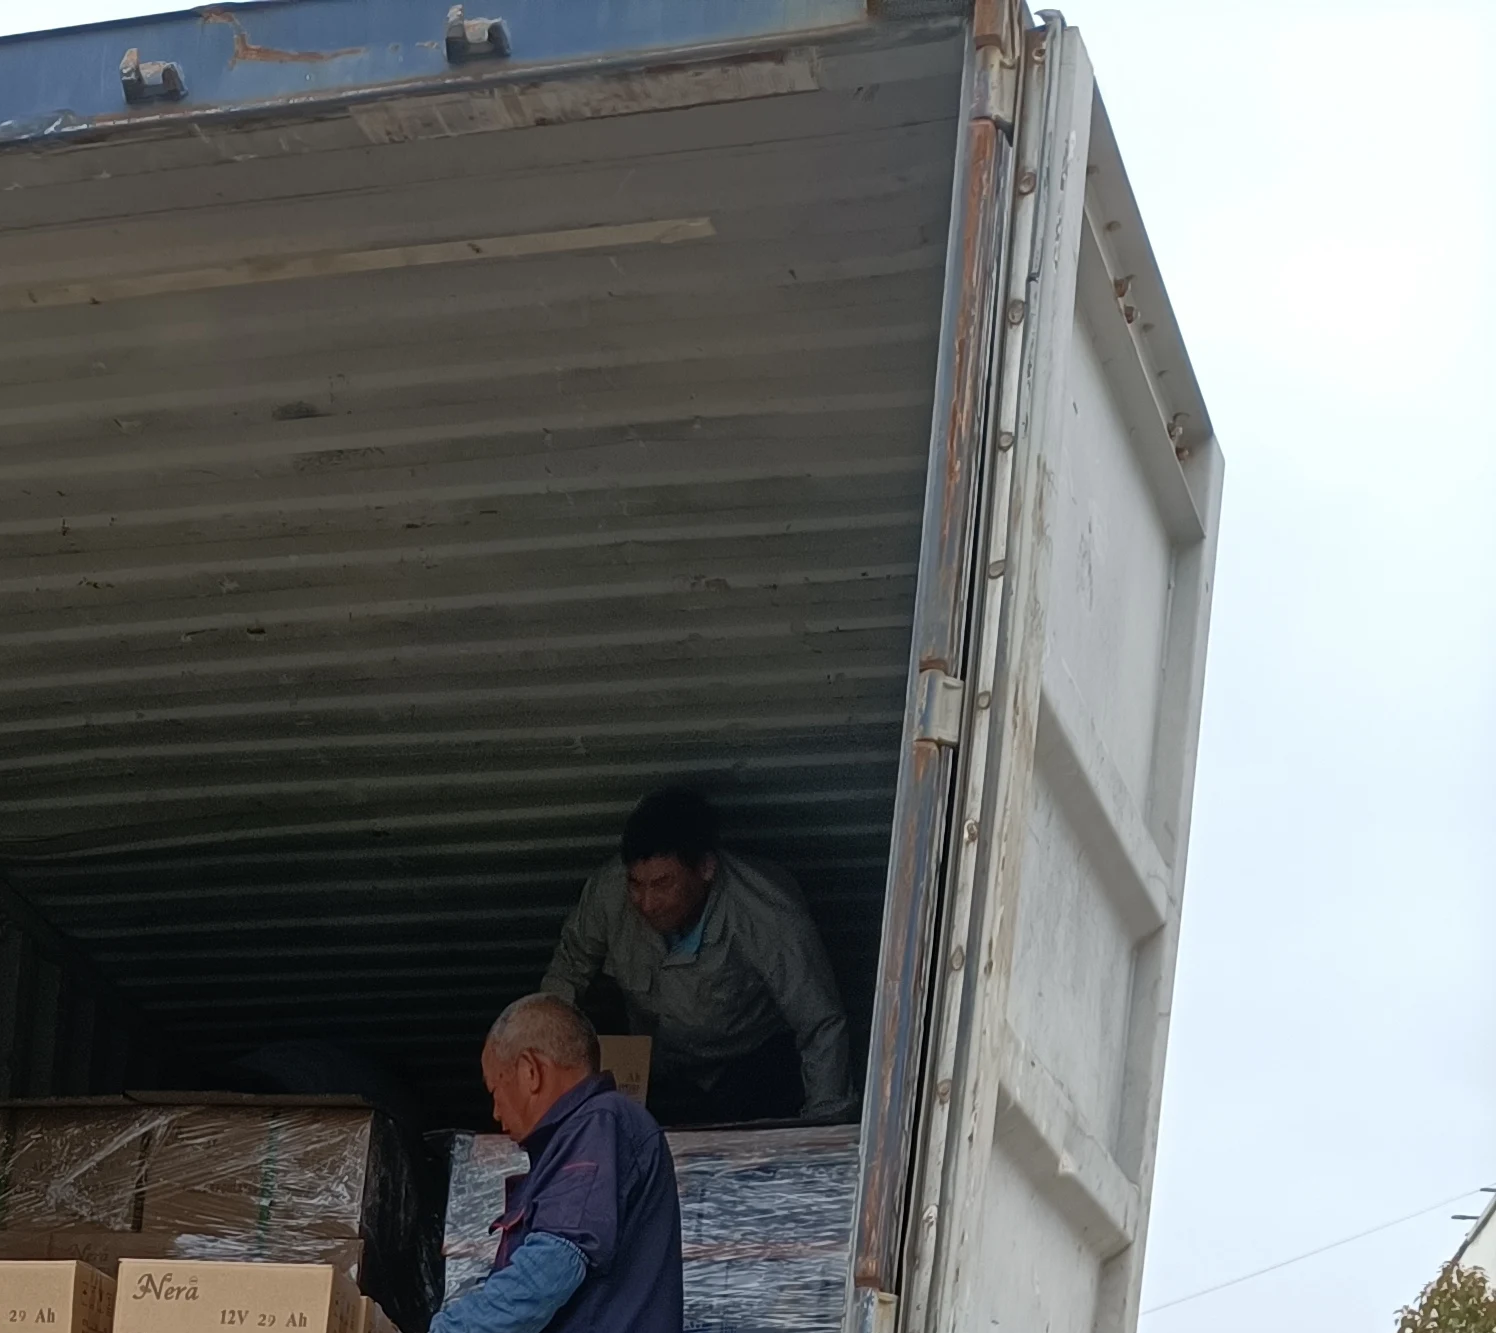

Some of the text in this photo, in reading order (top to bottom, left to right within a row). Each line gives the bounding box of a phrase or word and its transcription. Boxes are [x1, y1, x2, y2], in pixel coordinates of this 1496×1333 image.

[9, 1310, 26, 1322] 29
[35, 1308, 55, 1323] Ah
[220, 1309, 307, 1327] 12V 29 Ah
